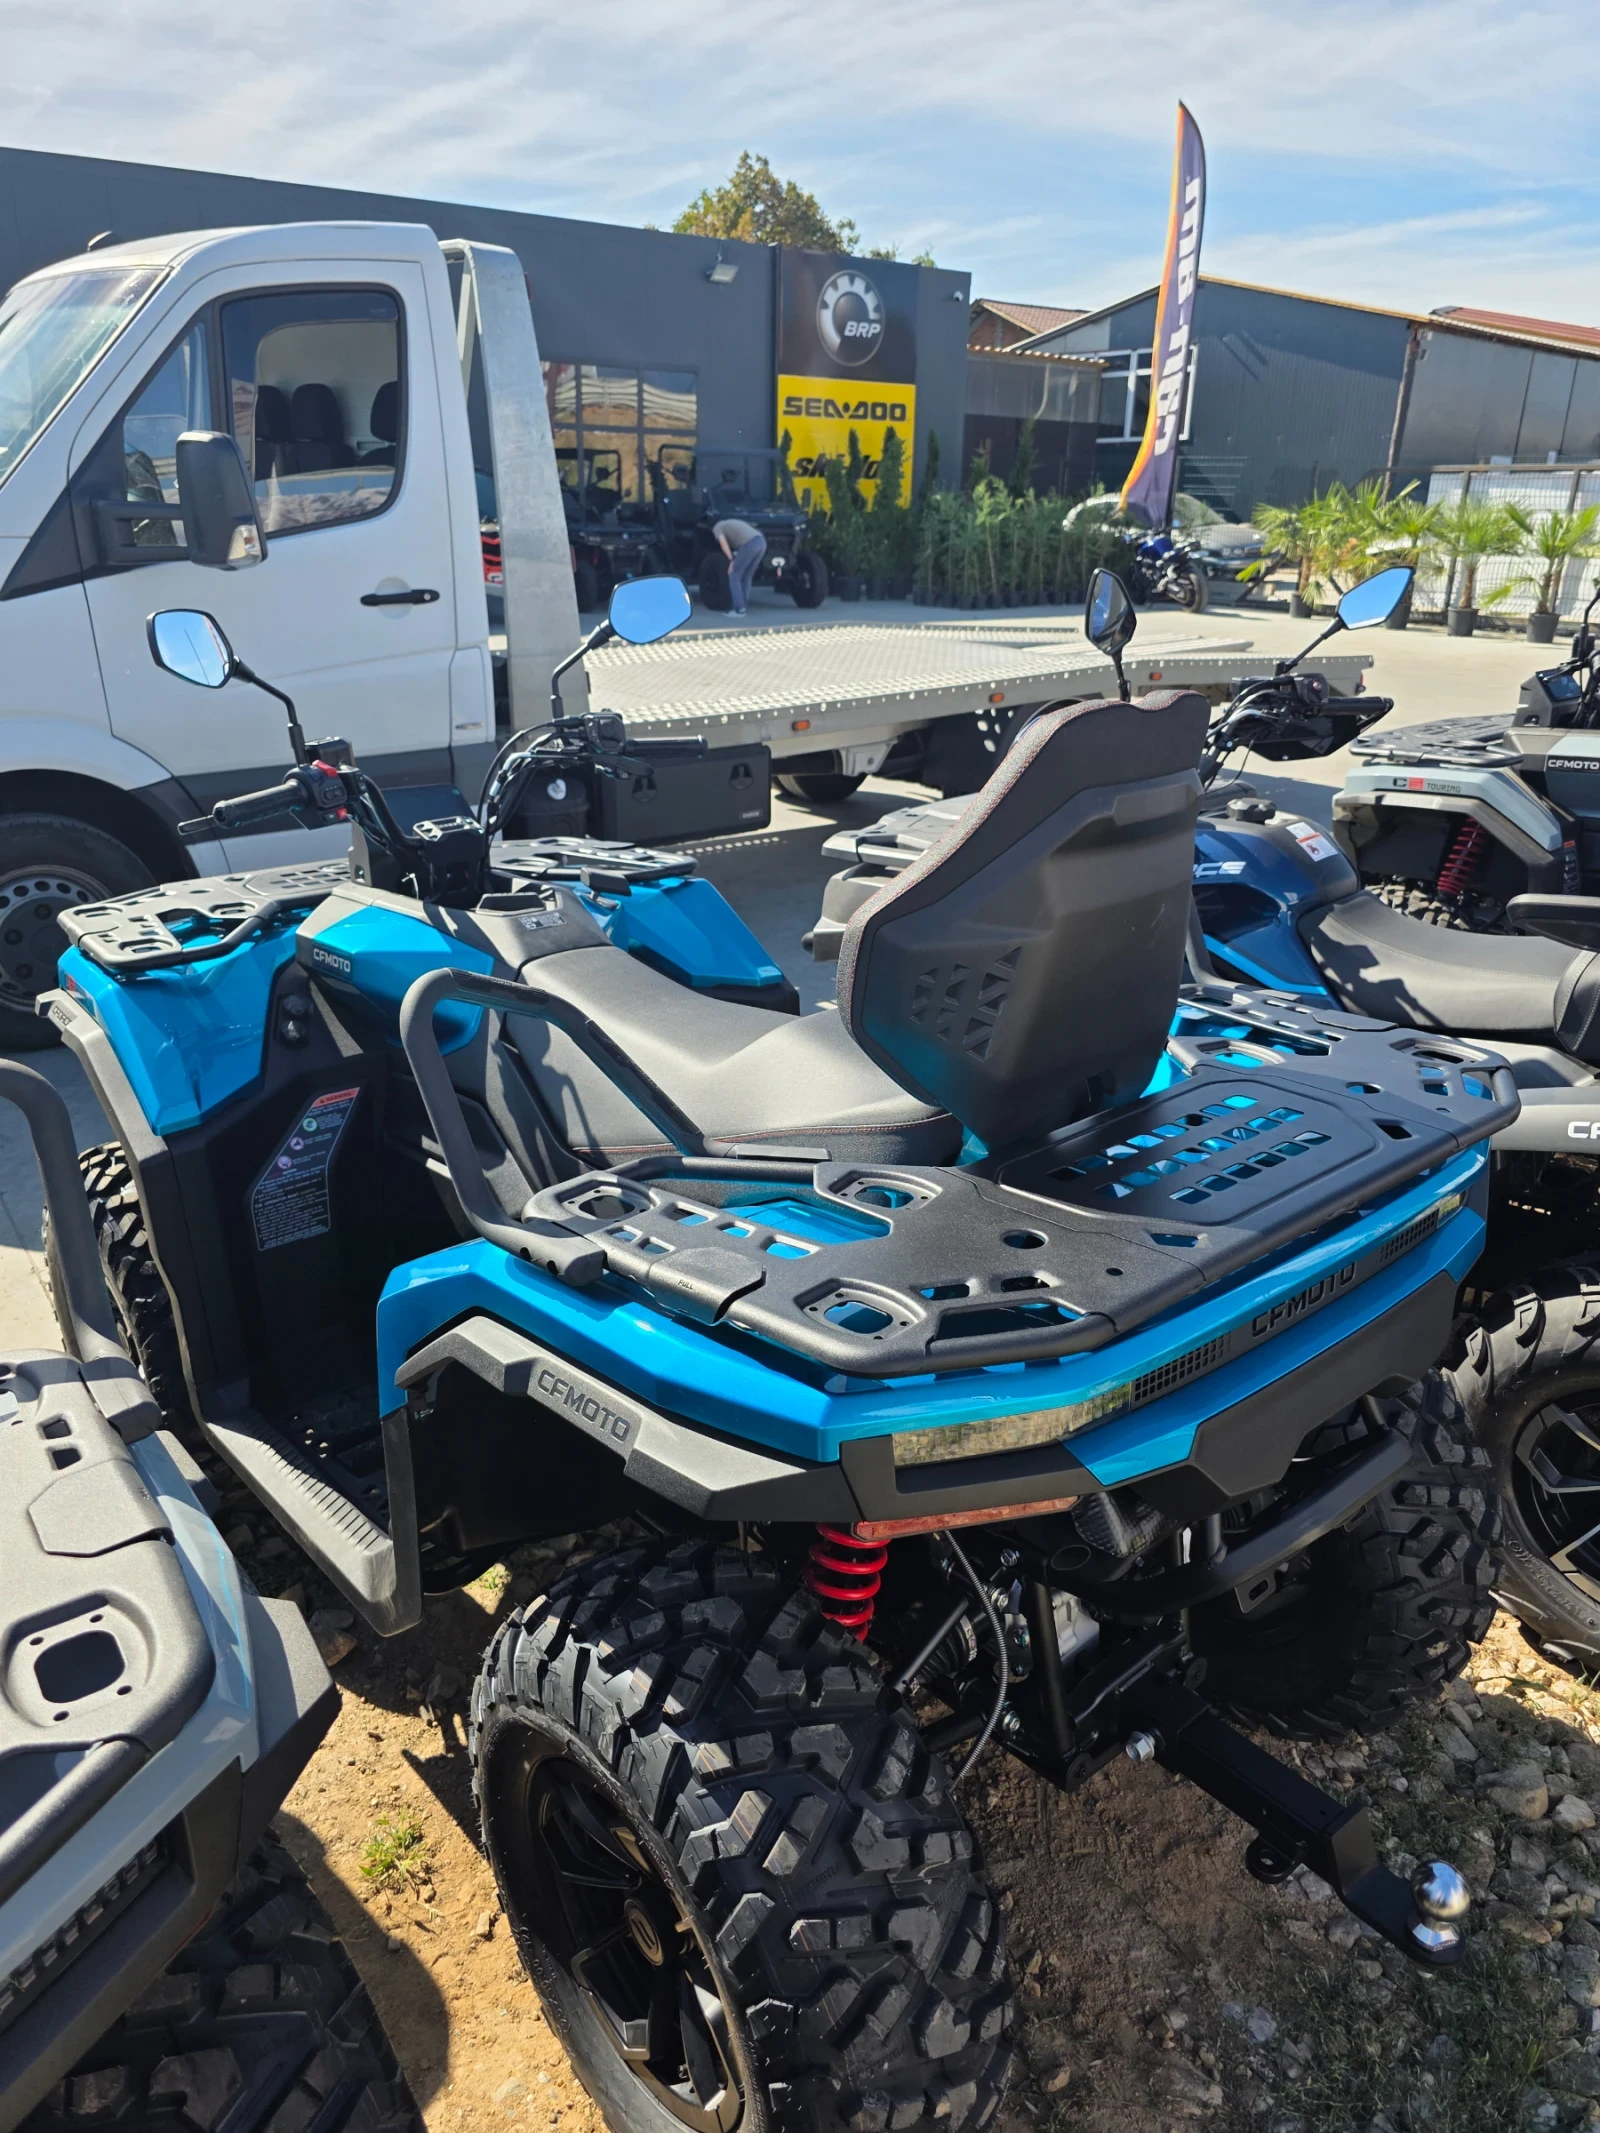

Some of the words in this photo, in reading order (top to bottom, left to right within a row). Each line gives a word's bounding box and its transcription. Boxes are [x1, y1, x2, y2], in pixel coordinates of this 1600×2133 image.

[843, 320, 881, 338] BRP
[1548, 759, 1600, 770] CFMOTO
[1426, 782, 1461, 794] TOURING
[313, 948, 351, 973] CFMOTO
[1252, 1262, 1356, 1337] CFMOTO
[538, 1369, 631, 1443] CFMOTO
